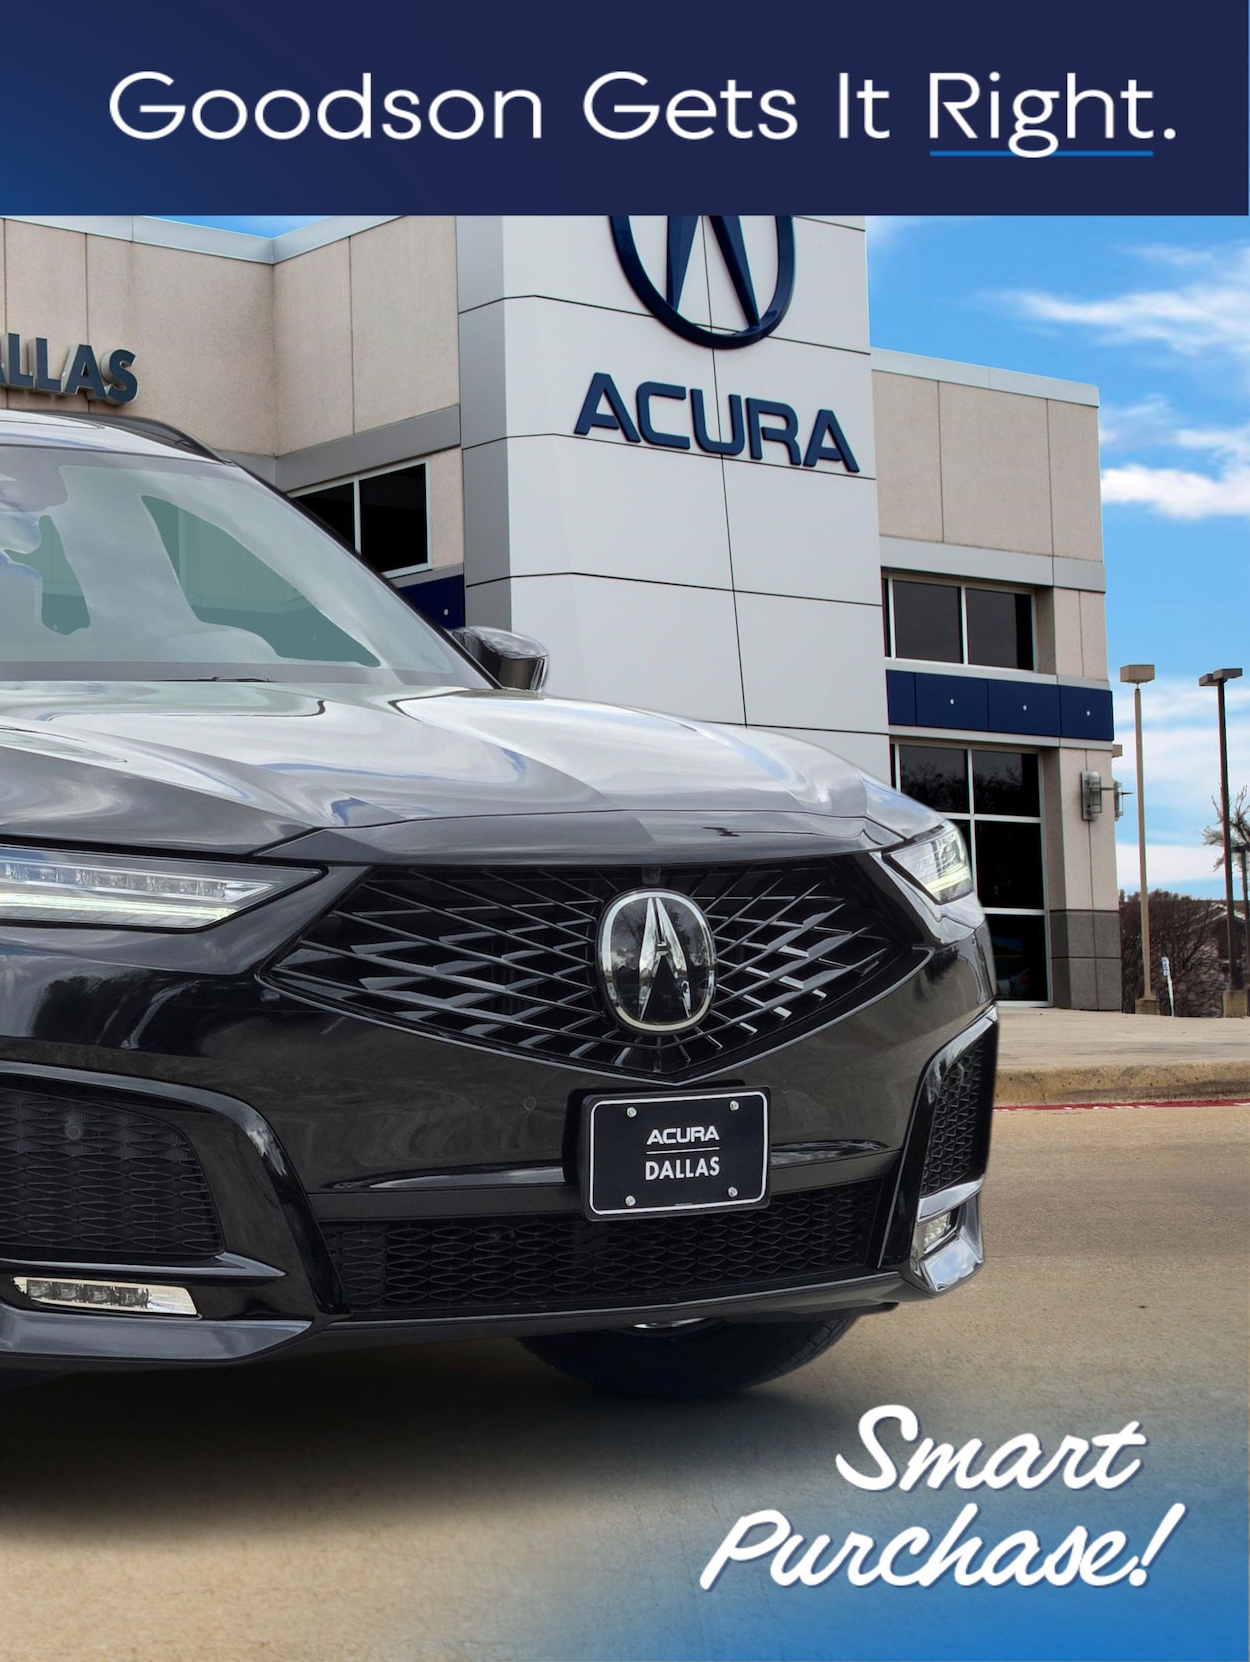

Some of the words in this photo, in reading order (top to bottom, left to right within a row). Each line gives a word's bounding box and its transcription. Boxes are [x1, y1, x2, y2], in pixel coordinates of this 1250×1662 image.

[573, 372, 861, 474] ACURA
[646, 1125, 720, 1145] ACURA
[645, 1156, 720, 1181] DALLAS
